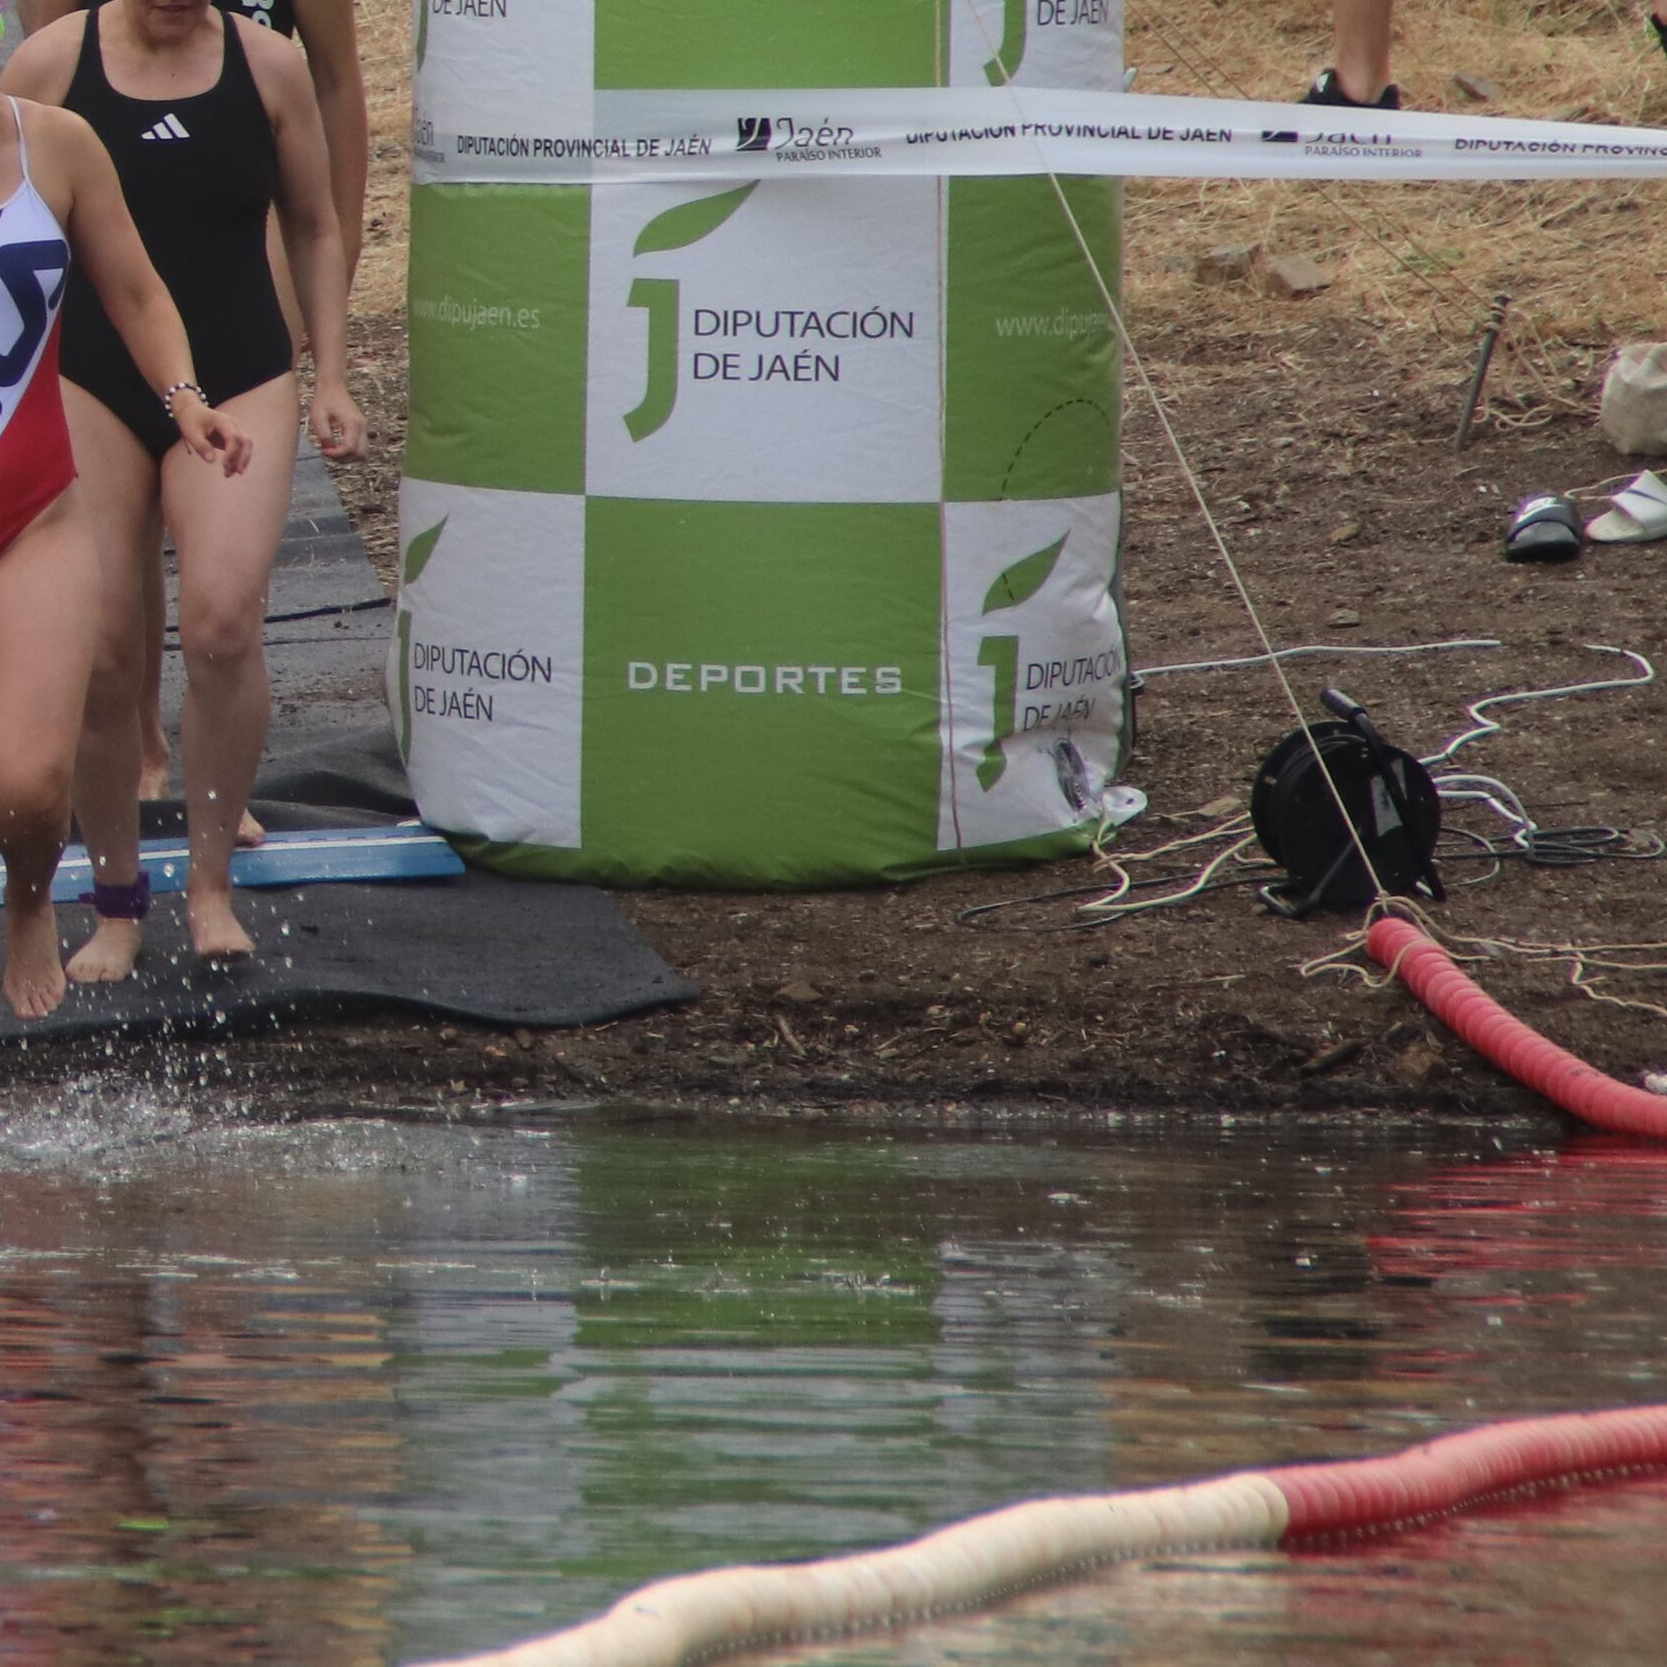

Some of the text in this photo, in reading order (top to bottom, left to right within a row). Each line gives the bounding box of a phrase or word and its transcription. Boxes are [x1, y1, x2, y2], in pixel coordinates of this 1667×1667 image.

[457, 133, 530, 157] DIPUTACIÓN
[533, 138, 631, 159] PROVINCIAL
[636, 138, 659, 158] DE
[664, 134, 713, 157] JAÉN
[775, 117, 855, 150] Jaén
[776, 146, 882, 163] PARAÍSO INTERIOR
[1363, 146, 1423, 158] INTERIOR
[693, 306, 915, 339] DIPUTACIÓN
[692, 348, 841, 383] DE JAÉN
[414, 641, 553, 684] DIPUTACIÓN
[627, 661, 903, 695] DEPORTES
[414, 688, 494, 722] DE JAÉN
